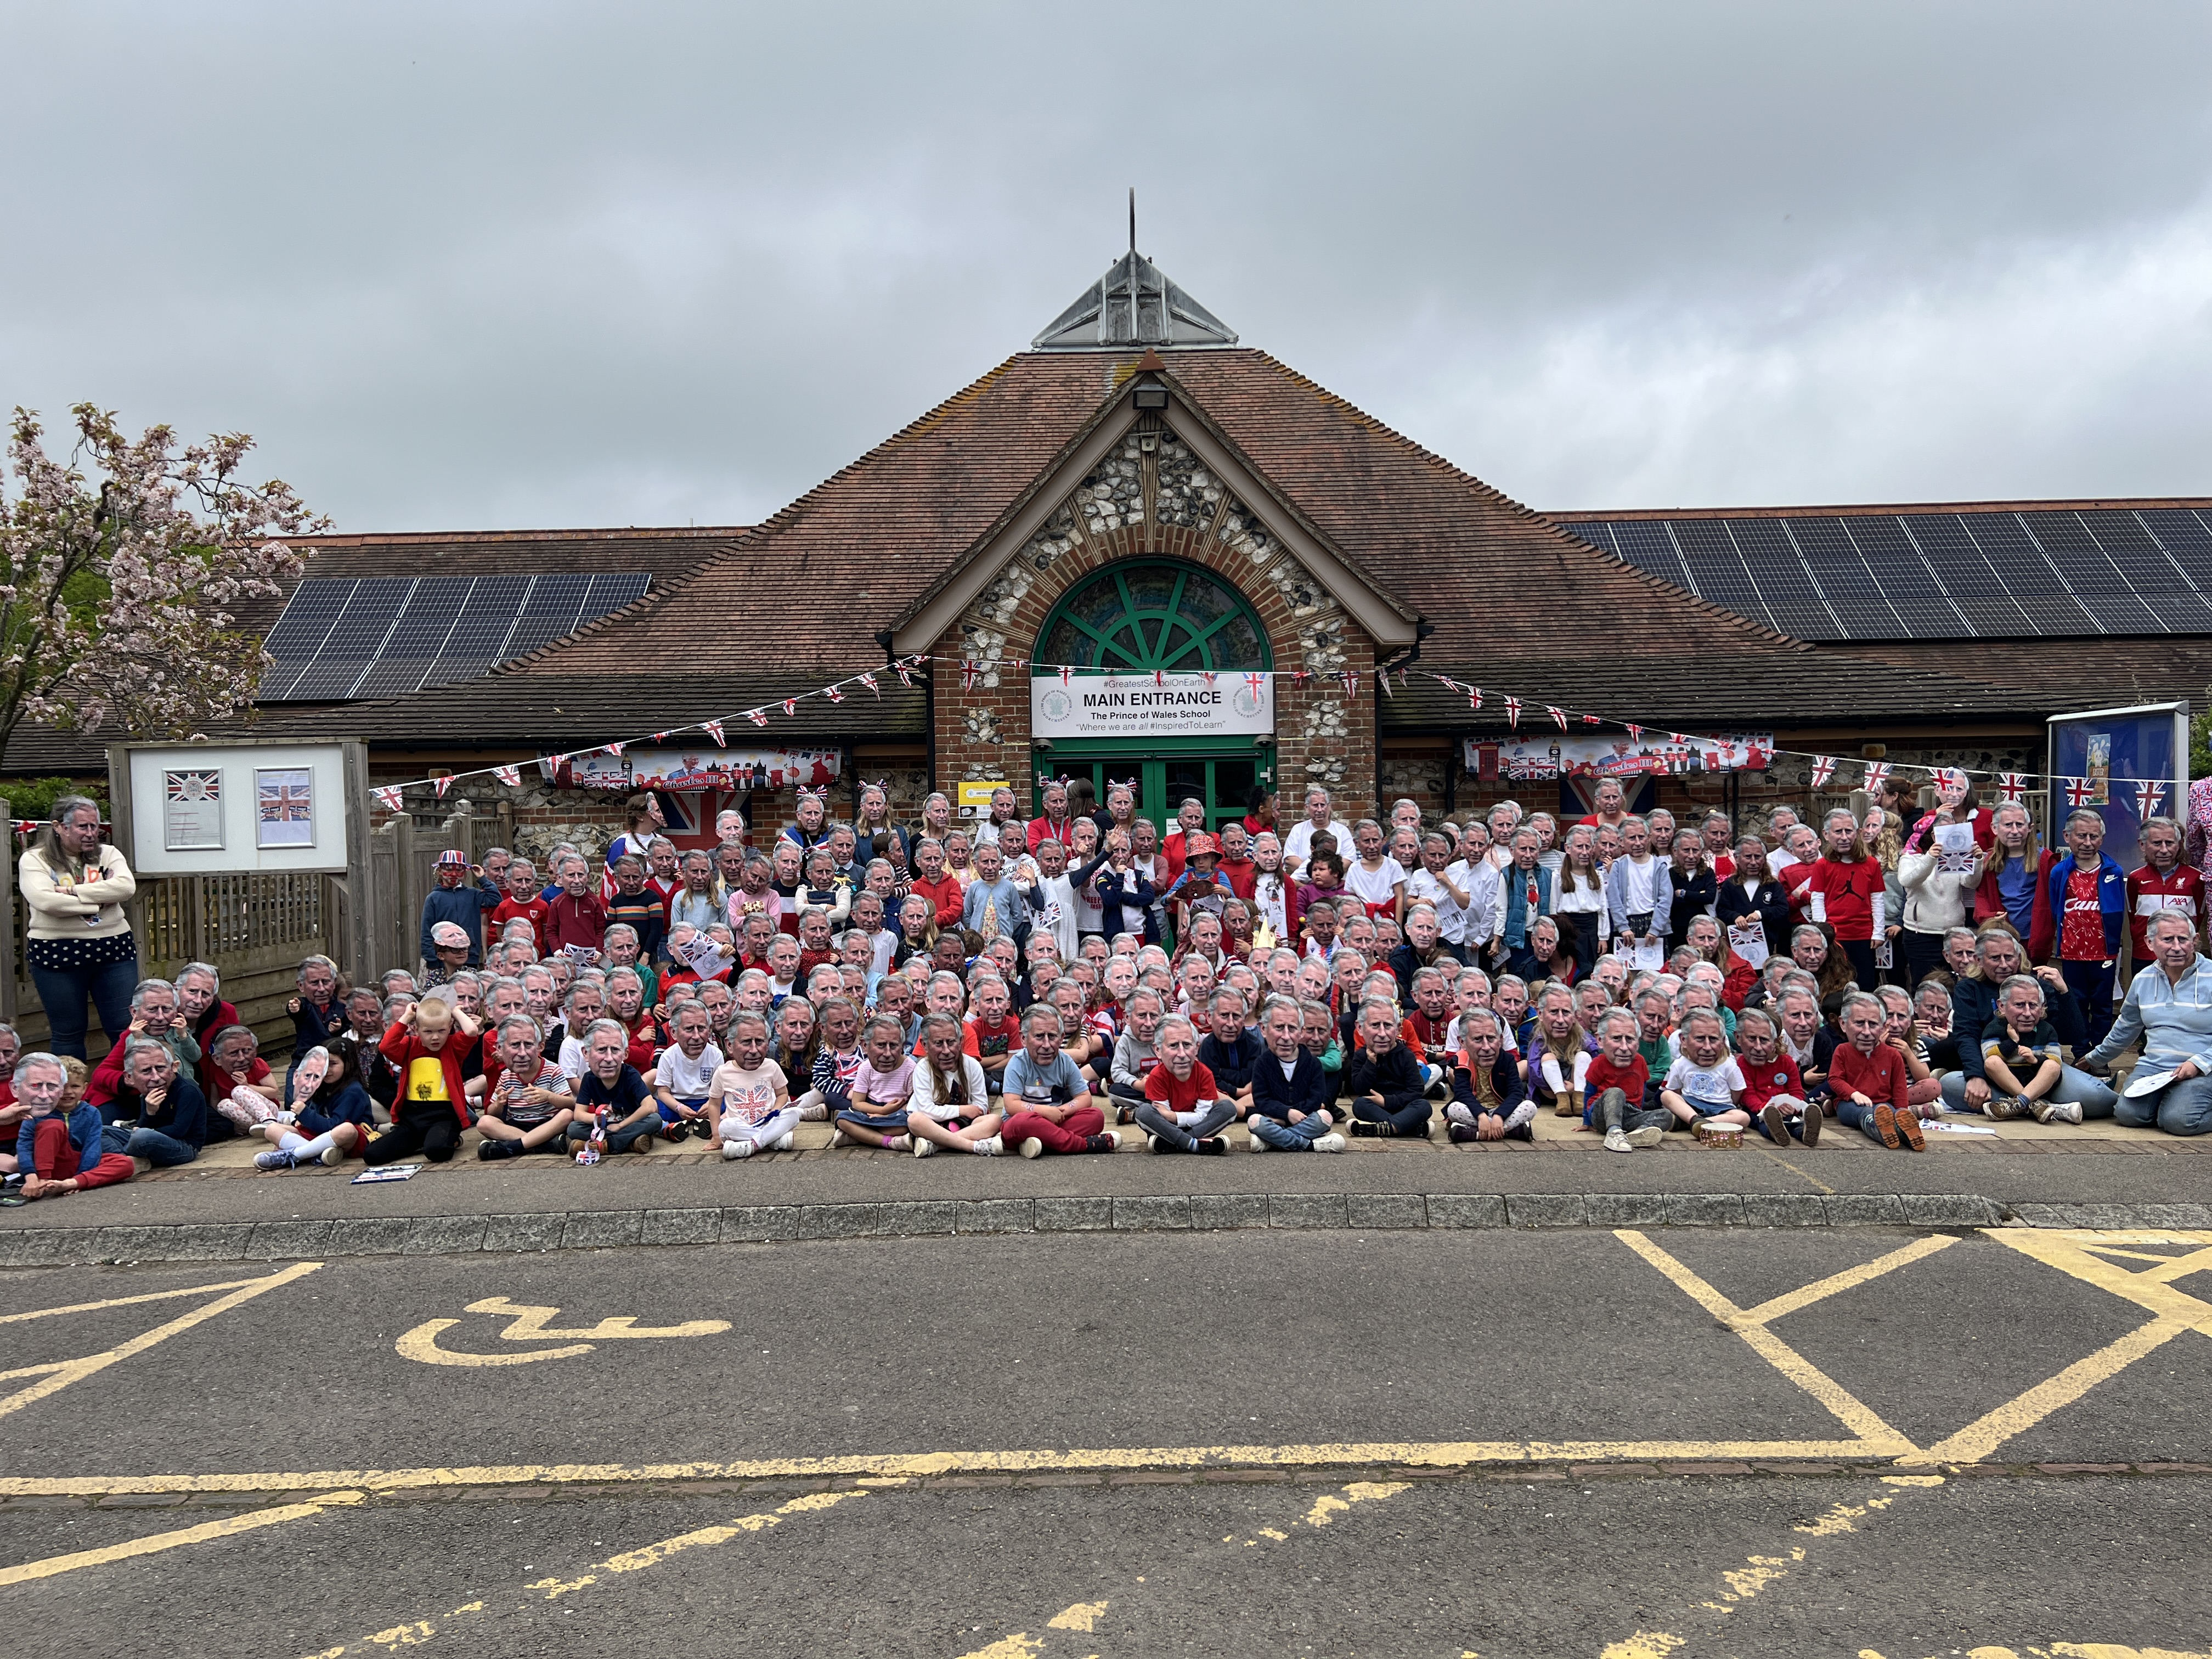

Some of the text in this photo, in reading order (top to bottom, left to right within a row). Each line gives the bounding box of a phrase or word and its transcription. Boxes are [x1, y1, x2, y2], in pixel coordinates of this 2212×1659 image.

[1084, 691, 1222, 707] MAIN ENTRANCE
[1042, 713, 1070, 723] DORCHESTER
[1138, 722, 1149, 730] all
[1594, 759, 1653, 775] Charles III
[663, 775, 719, 789] Charles III
[2168, 897, 2188, 906] AXA
